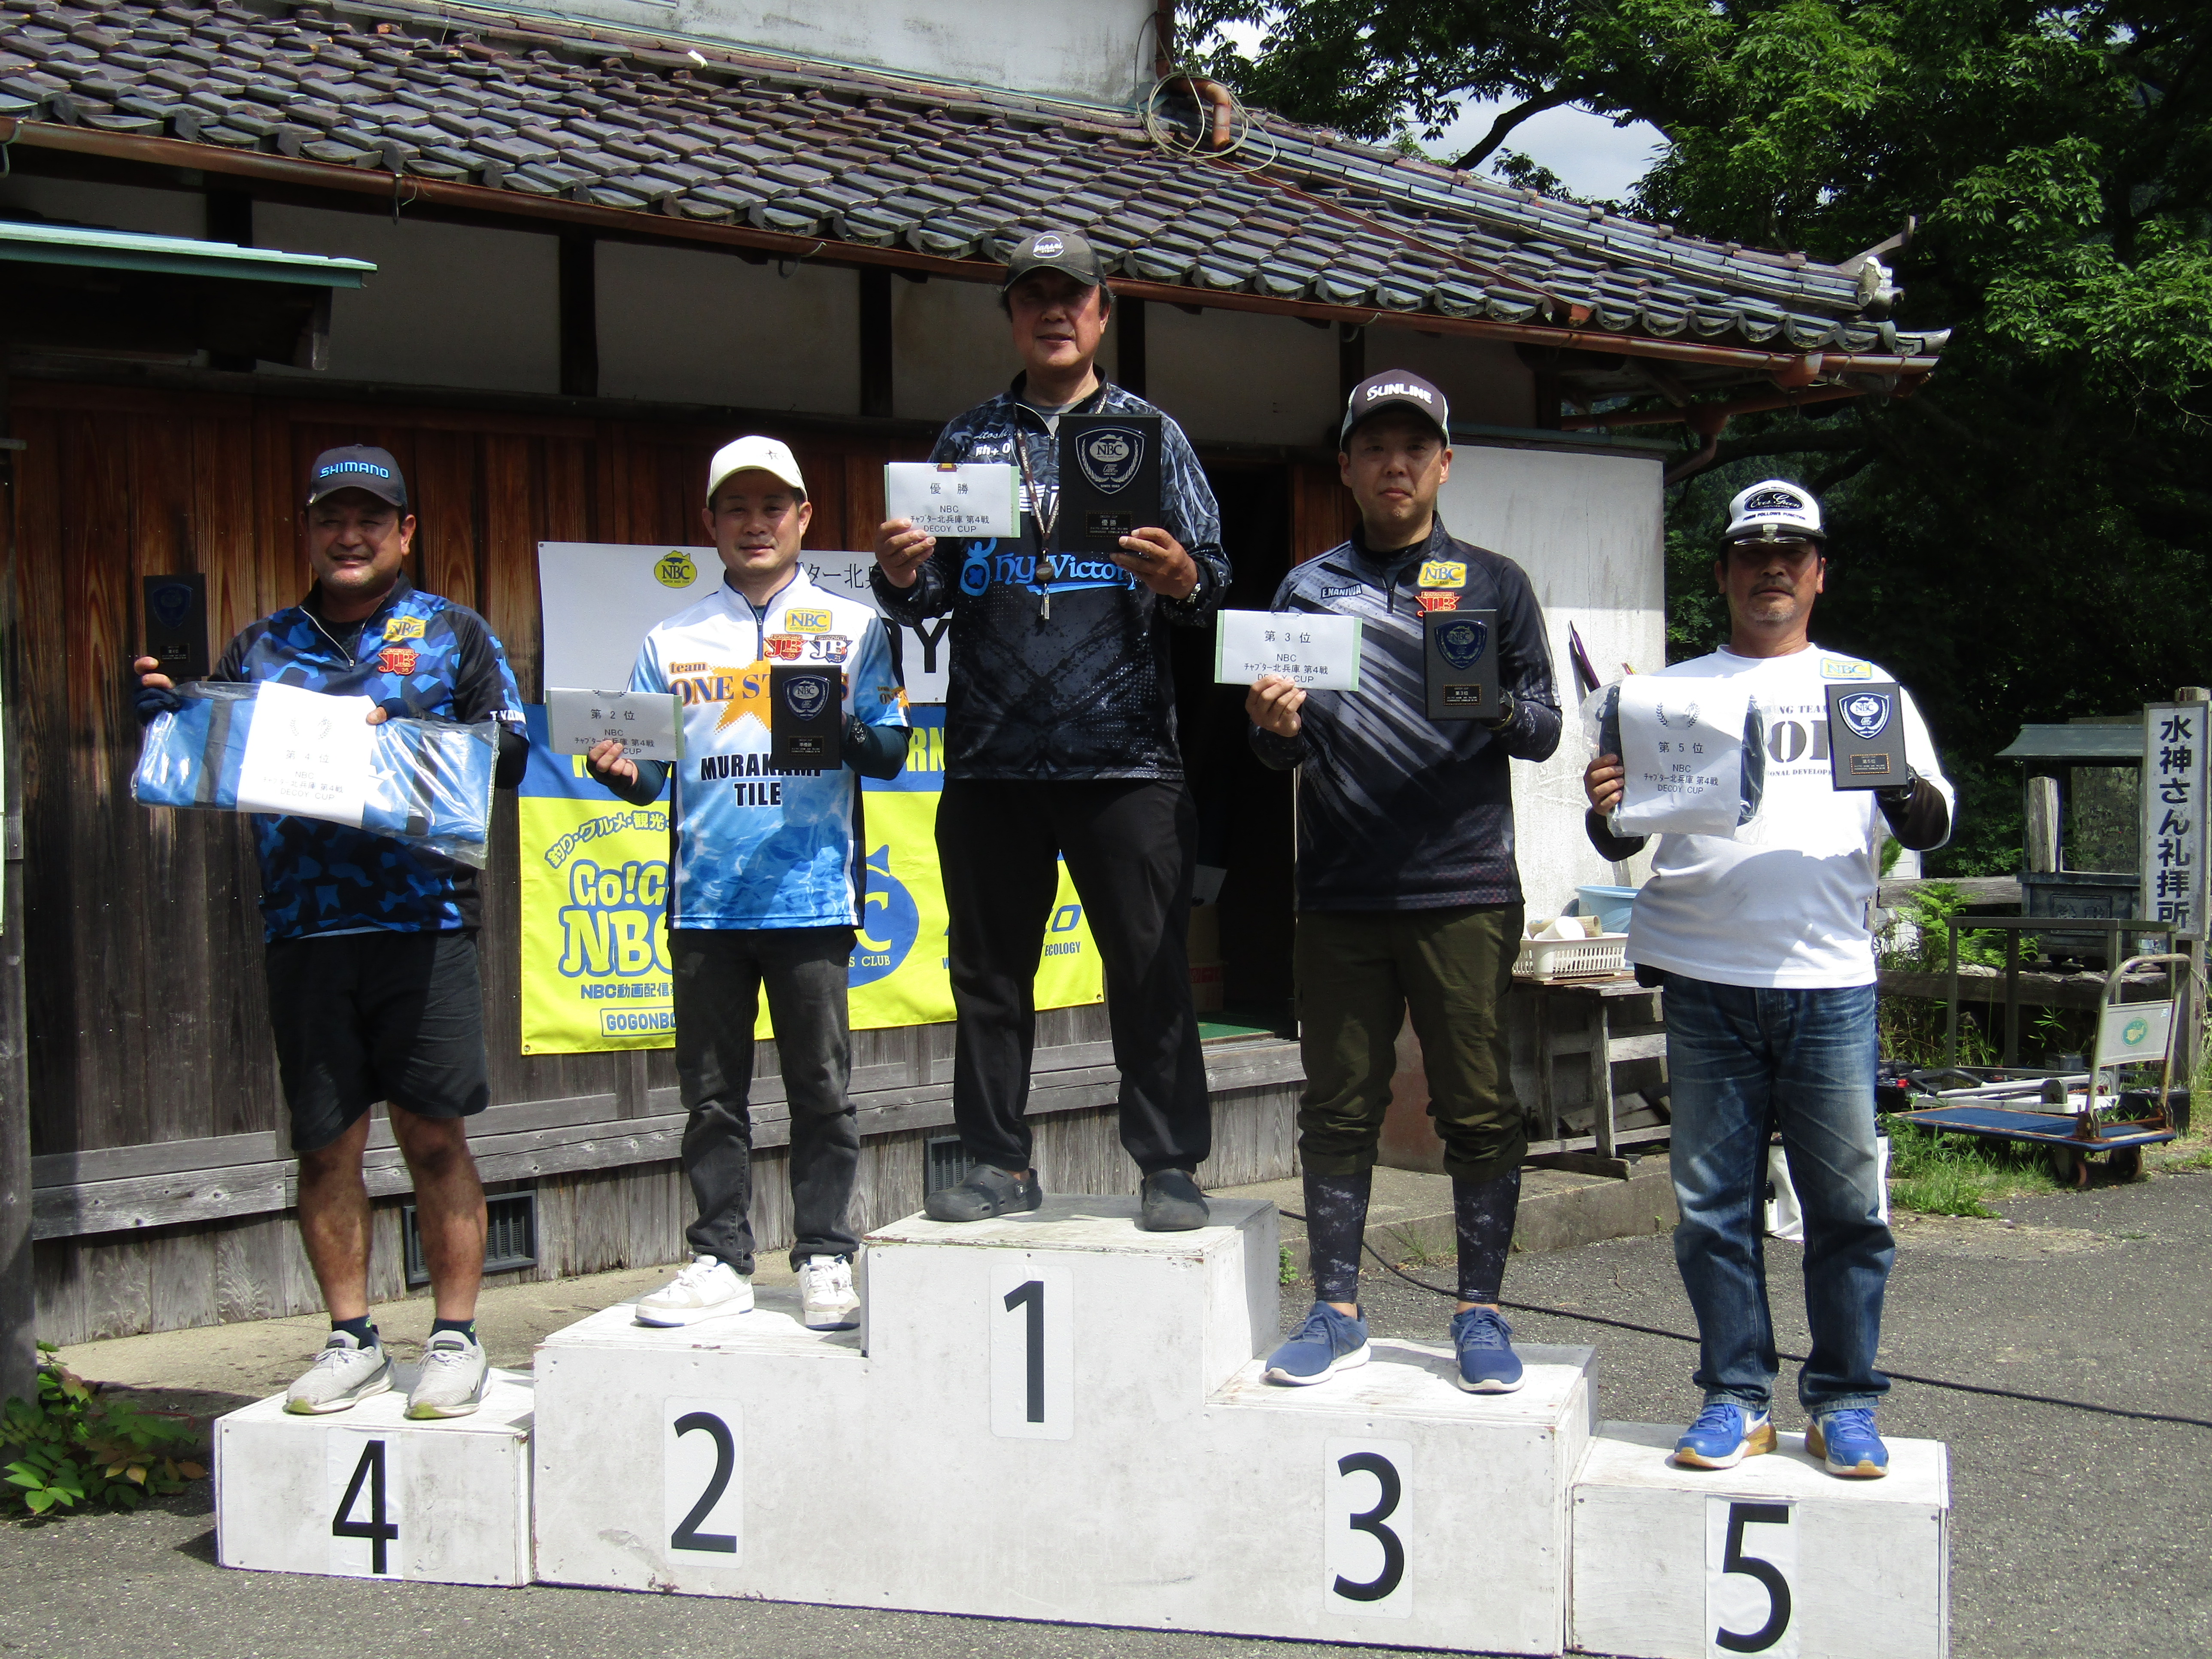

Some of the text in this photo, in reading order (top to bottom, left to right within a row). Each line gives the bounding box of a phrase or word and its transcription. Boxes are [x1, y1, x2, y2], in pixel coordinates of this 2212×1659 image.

[1367, 383, 1432, 404] SUNLINE
[1097, 444, 1123, 456] NBC
[319, 462, 389, 478] SHIMANO
[966, 515, 990, 524] 第4戦
[662, 565, 690, 580] NBC
[1423, 566, 1461, 581] NBC
[790, 612, 827, 627] NBC
[1276, 653, 1297, 662] NBC
[671, 663, 706, 673] team
[1304, 665, 1328, 675] 第4戦
[1826, 663, 1867, 674] NBC
[670, 676, 734, 704] ONE
[631, 739, 655, 747] 第4戦
[295, 771, 314, 779] NBC
[1673, 764, 1691, 773] NBC
[1696, 776, 1719, 786] 第4戦
[280, 788, 310, 797] DECOY
[734, 782, 781, 806] TILE
[1658, 784, 1704, 794] DECOY CUP
[2157, 714, 2192, 929] 水神さん礼拝所
[1044, 941, 1081, 957] ECOLOGY
[861, 955, 891, 966] CLUB
[581, 982, 674, 999] NBC動画配信
[1004, 1281, 1044, 1422] 1
[671, 1412, 735, 1553] 2
[332, 1440, 398, 1574] 4
[1333, 1452, 1404, 1601] 3
[1716, 1502, 1791, 1653] 5
